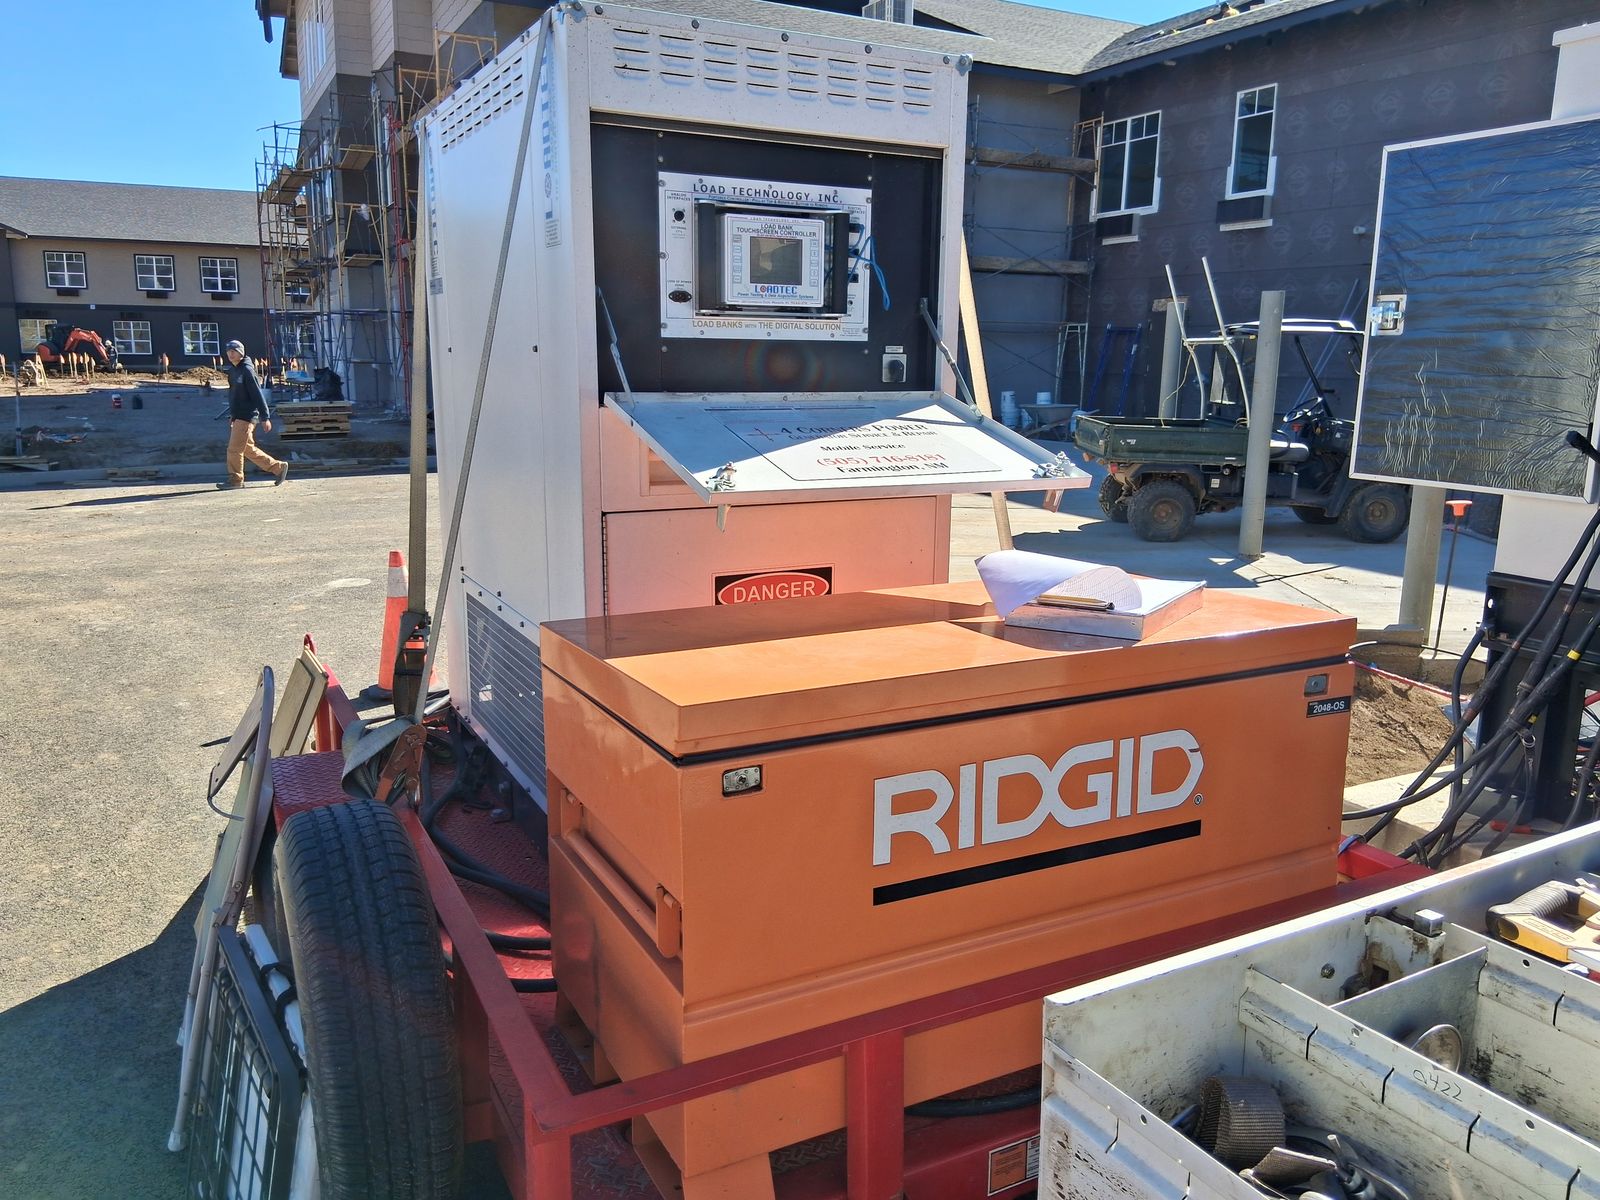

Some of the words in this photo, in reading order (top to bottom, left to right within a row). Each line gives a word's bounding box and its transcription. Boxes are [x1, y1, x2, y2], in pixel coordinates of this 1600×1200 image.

[693, 183, 726, 194] LOAD
[731, 186, 814, 202] TECHNOLOGY,
[818, 194, 843, 204] INC.
[736, 227, 779, 235] TOUCHSCREEN
[779, 229, 817, 238] CONTROLLER
[754, 284, 798, 295] LOADTEC
[692, 320, 716, 329] LOAD
[716, 320, 743, 329] BANKS
[758, 321, 774, 330] THE
[775, 322, 804, 331] DIGITAL
[805, 322, 841, 331] SOLUTION
[872, 423, 928, 433] POWER
[820, 444, 861, 452] Mobile
[817, 456, 869, 467] (505)
[837, 464, 926, 474] Farmington,
[926, 461, 949, 470] NM
[733, 580, 816, 604] DANGER
[1313, 701, 1345, 713] 2048-OS
[872, 729, 1204, 866] RIDGID
